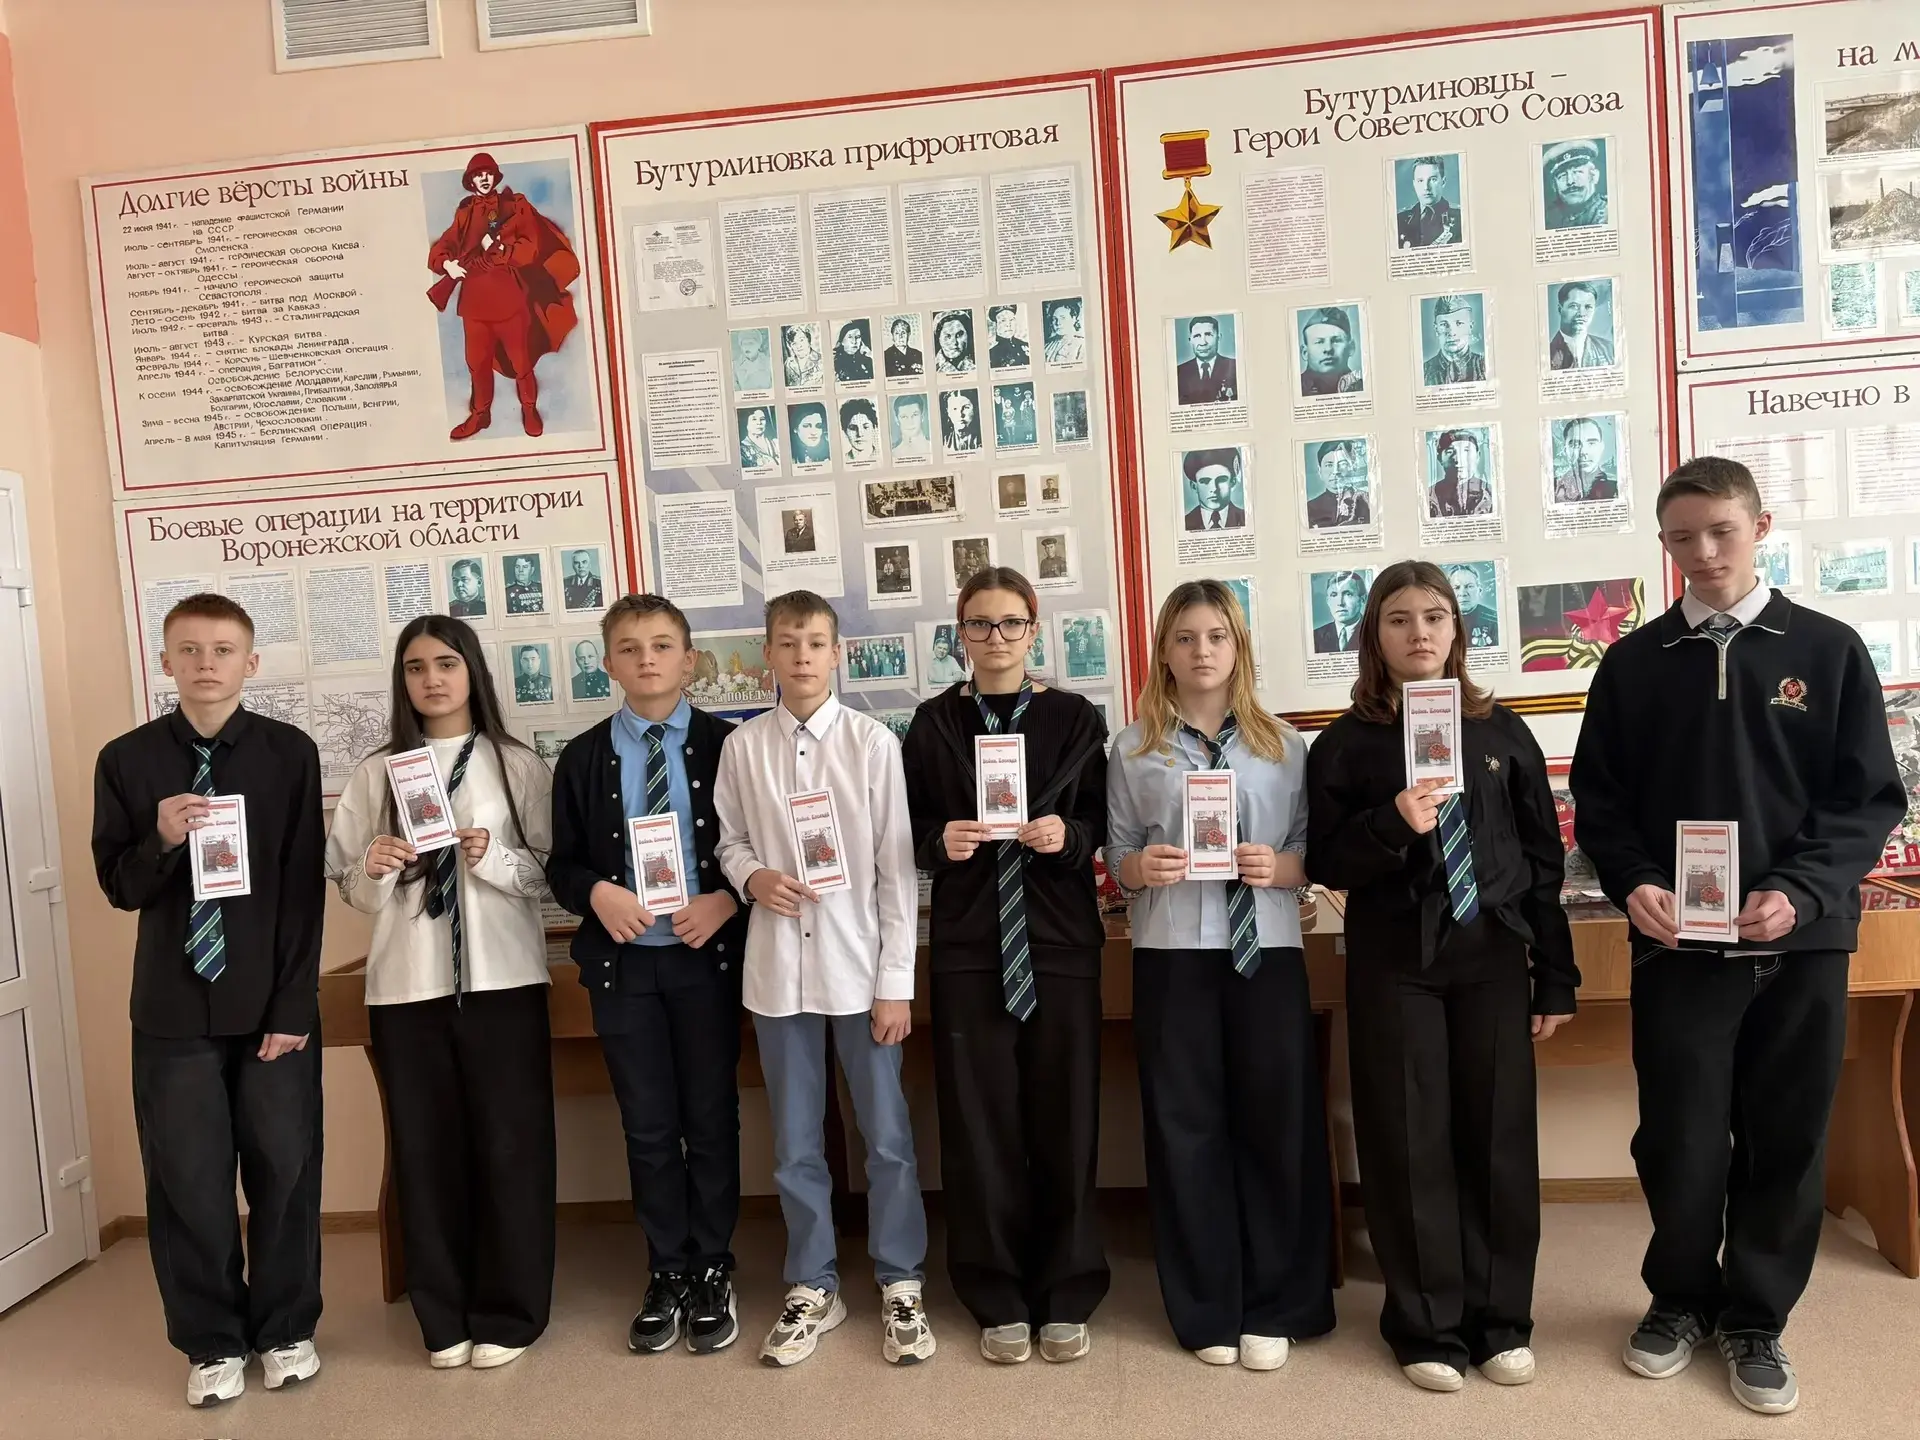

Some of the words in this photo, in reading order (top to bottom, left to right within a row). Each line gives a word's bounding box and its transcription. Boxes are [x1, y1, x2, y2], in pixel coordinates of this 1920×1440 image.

[1837, 46, 1878, 67] на
[1304, 71, 1536, 120] Бутурлиновцы
[1233, 127, 1320, 156] Герои
[1332, 95, 1508, 141] Советского
[1522, 92, 1624, 120] Союза
[634, 149, 836, 191] Бутурлиновка
[844, 124, 1059, 170] прифронтовая
[119, 188, 209, 217] Долгие
[218, 178, 313, 208] вёрсты
[323, 169, 409, 193] войны
[133, 224, 154, 233] июня
[155, 222, 172, 230] 1941
[191, 216, 232, 227] нападение
[297, 205, 344, 216] Германии
[156, 239, 203, 249] сентябрь
[207, 234, 225, 244] 1941
[243, 229, 298, 241] героическая
[303, 225, 342, 235] оборона
[126, 271, 155, 280] Август
[164, 267, 201, 277] октябрь
[202, 264, 220, 273] 1941
[240, 258, 298, 269] героическая
[304, 252, 344, 264] оборона
[158, 259, 185, 268] август
[189, 256, 207, 265] 1941
[228, 248, 286, 261] героическая
[289, 244, 328, 255] оборона
[128, 290, 160, 299] Ноябрь
[162, 286, 181, 295] 1941
[203, 281, 239, 291] начало
[243, 275, 302, 289] героической
[308, 272, 344, 282] защиты
[221, 300, 240, 309] 1941
[259, 297, 285, 306] битва
[288, 294, 308, 303] под
[131, 317, 156, 326] Лето
[164, 314, 196, 323] осень
[199, 310, 221, 320] 1942
[241, 307, 268, 316] битва
[160, 323, 179, 333] 1942
[196, 320, 238, 329] февраль
[241, 315, 263, 325] 1943
[282, 308, 360, 322] Сталинградская
[169, 342, 198, 351] август
[204, 337, 225, 348] 1943
[248, 333, 290, 344] Курская
[135, 355, 166, 364] Январь
[170, 351, 190, 360] 1944
[252, 344, 294, 353] блокады
[135, 362, 180, 372] Февраль
[183, 359, 202, 369] 1944
[137, 372, 171, 381] Апрель
[174, 369, 196, 378] 1944
[217, 364, 262, 374] операция
[147, 391, 176, 400] осени
[182, 387, 203, 396] 1944
[224, 380, 293, 393] освобождение
[207, 372, 281, 386] Освобождение
[209, 391, 266, 404] Закарпатской
[1748, 386, 1880, 415] Навечно
[1894, 385, 1910, 403] в
[142, 419, 164, 428] Зима
[173, 416, 200, 425] весна
[203, 413, 224, 422] 1945
[243, 406, 316, 419] освобождение
[193, 434, 212, 442] мая
[215, 430, 237, 440] 1945
[259, 424, 316, 437] Берлинская
[214, 438, 276, 449] Капитуляция
[147, 517, 243, 541] Боевые
[256, 507, 381, 536] операции
[391, 504, 425, 522] на
[430, 490, 583, 523] территории
[221, 527, 401, 566] Воронежской
[410, 523, 520, 547] области
[687, 694, 709, 704] сибо
[713, 695, 723, 703] за
[727, 689, 772, 703] ПОБЕДУ!
